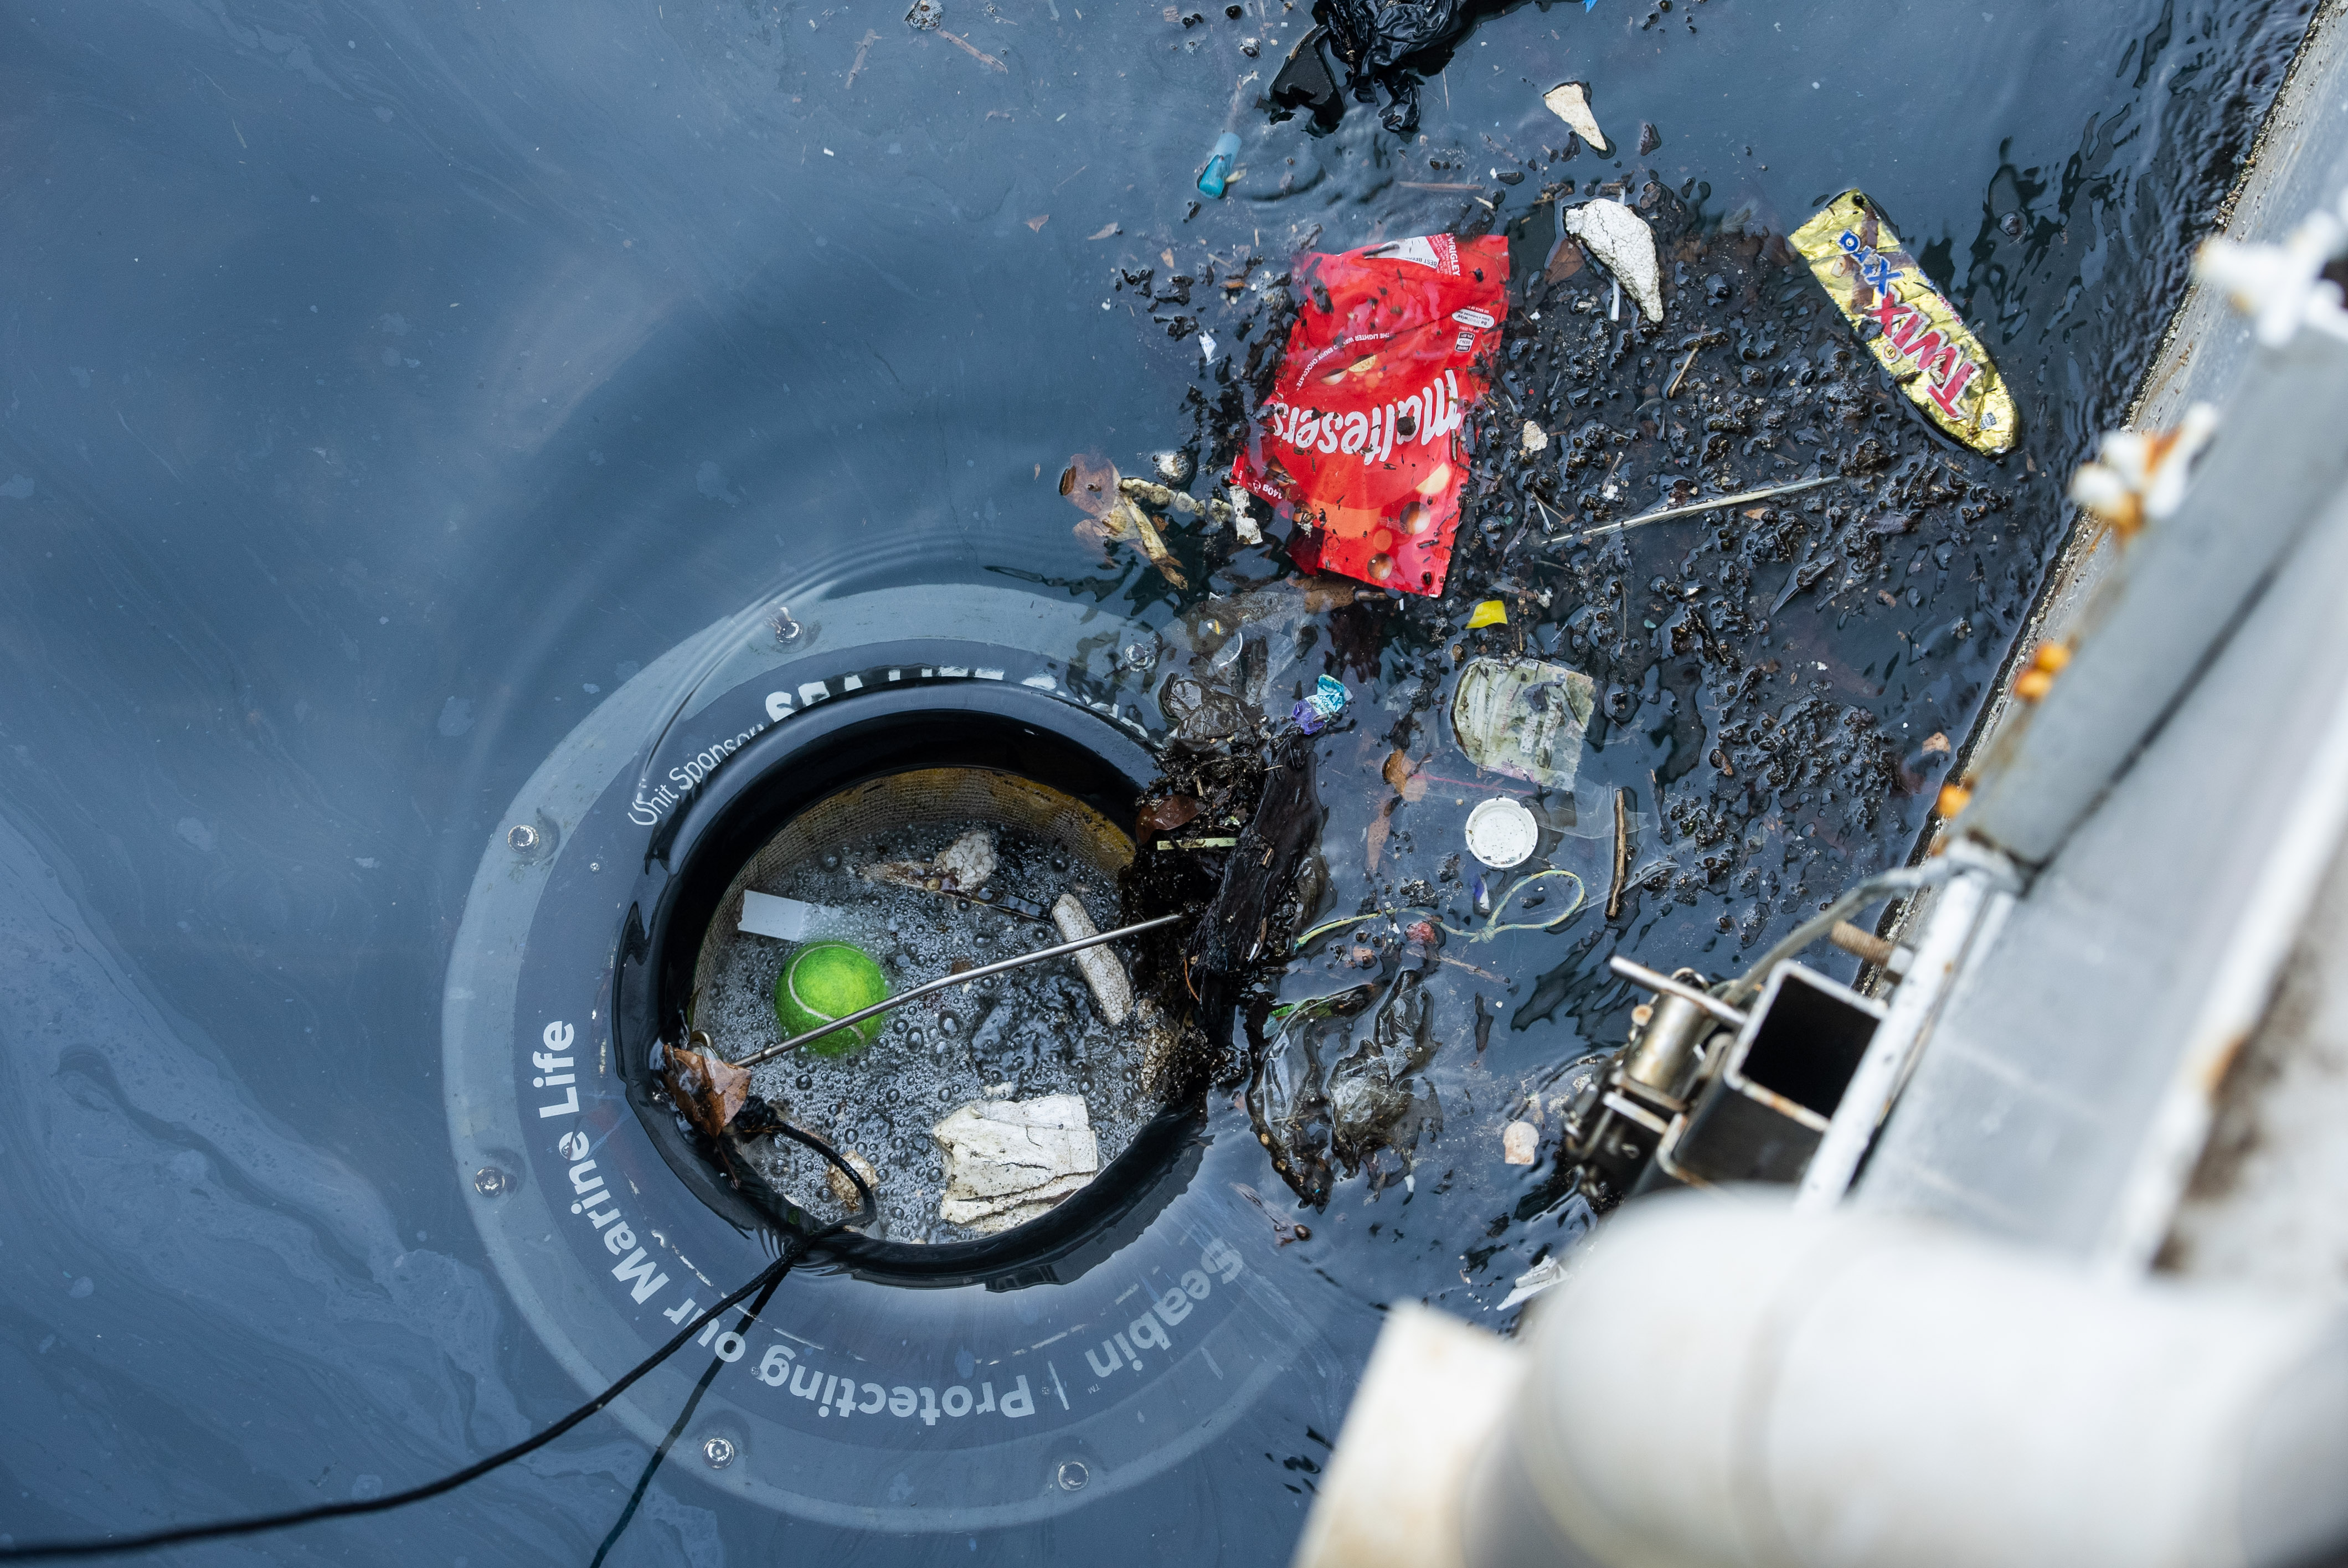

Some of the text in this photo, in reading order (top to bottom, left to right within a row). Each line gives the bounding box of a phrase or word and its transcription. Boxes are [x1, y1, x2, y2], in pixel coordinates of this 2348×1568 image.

[1448, 236, 1460, 276] WRIGLEY
[1317, 347, 1333, 360] ENJOY
[1355, 333, 1378, 342] LIGHTER
[1296, 358, 1318, 388] CHOCOLATE
[1263, 484, 1283, 499] 140g
[1500, 714, 1508, 736] TIPPED
[627, 785, 679, 826] Unit
[532, 1020, 580, 1118] Life
[559, 1131, 670, 1304] Marine
[1085, 1237, 1243, 1378] Seabin
[664, 1298, 746, 1362] our
[760, 1344, 1036, 1426] Protecting
